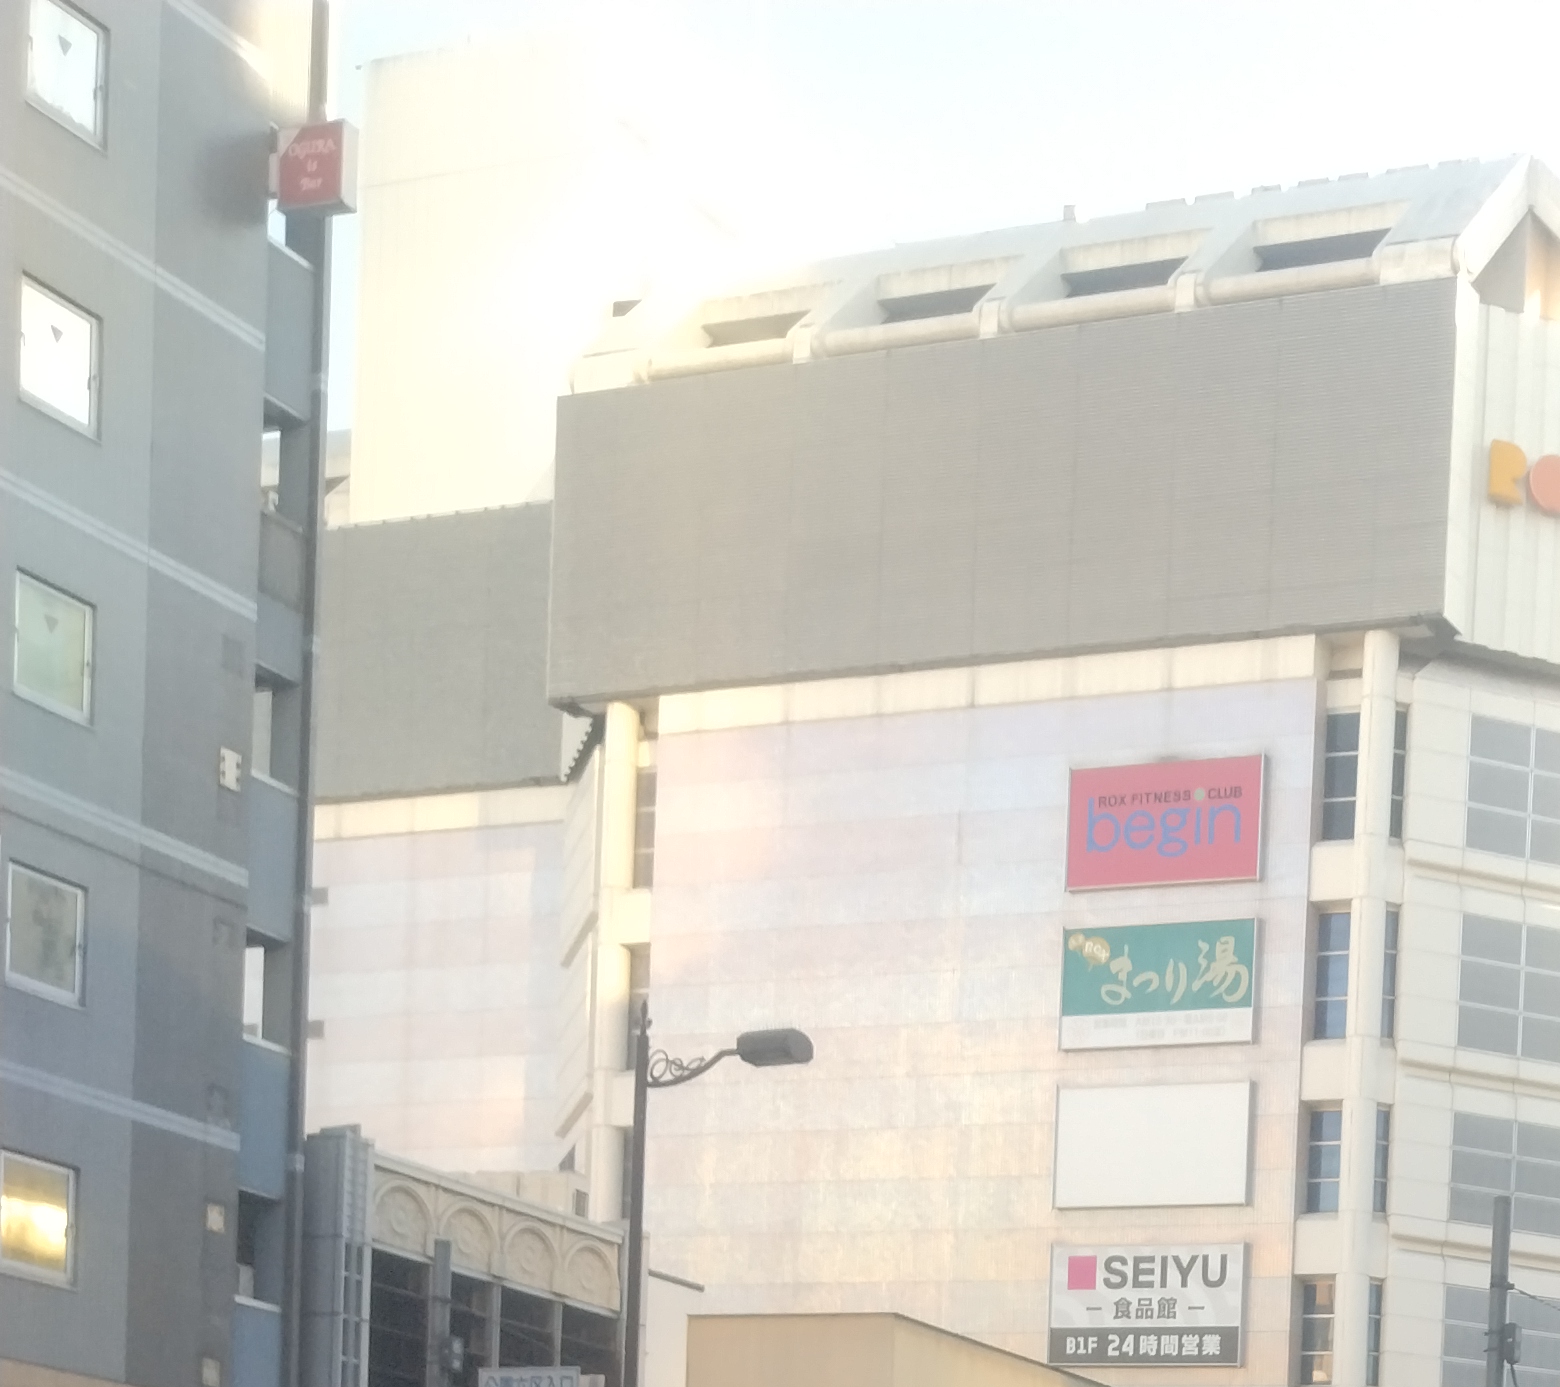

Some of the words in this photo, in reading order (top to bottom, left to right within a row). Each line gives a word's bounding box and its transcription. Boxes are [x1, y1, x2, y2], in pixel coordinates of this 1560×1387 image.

[1098, 794, 1127, 809] ROX
[1131, 789, 1191, 806] FITNESS
[1207, 785, 1243, 800] CLUB
[1086, 796, 1242, 858] begin
[1100, 935, 1249, 1006] まつり湯
[1102, 1254, 1228, 1290] SEIYU
[1113, 1297, 1178, 1320] 食品館
[1065, 1336, 1098, 1355] B1F
[1107, 1333, 1222, 1357] 24時間営業
